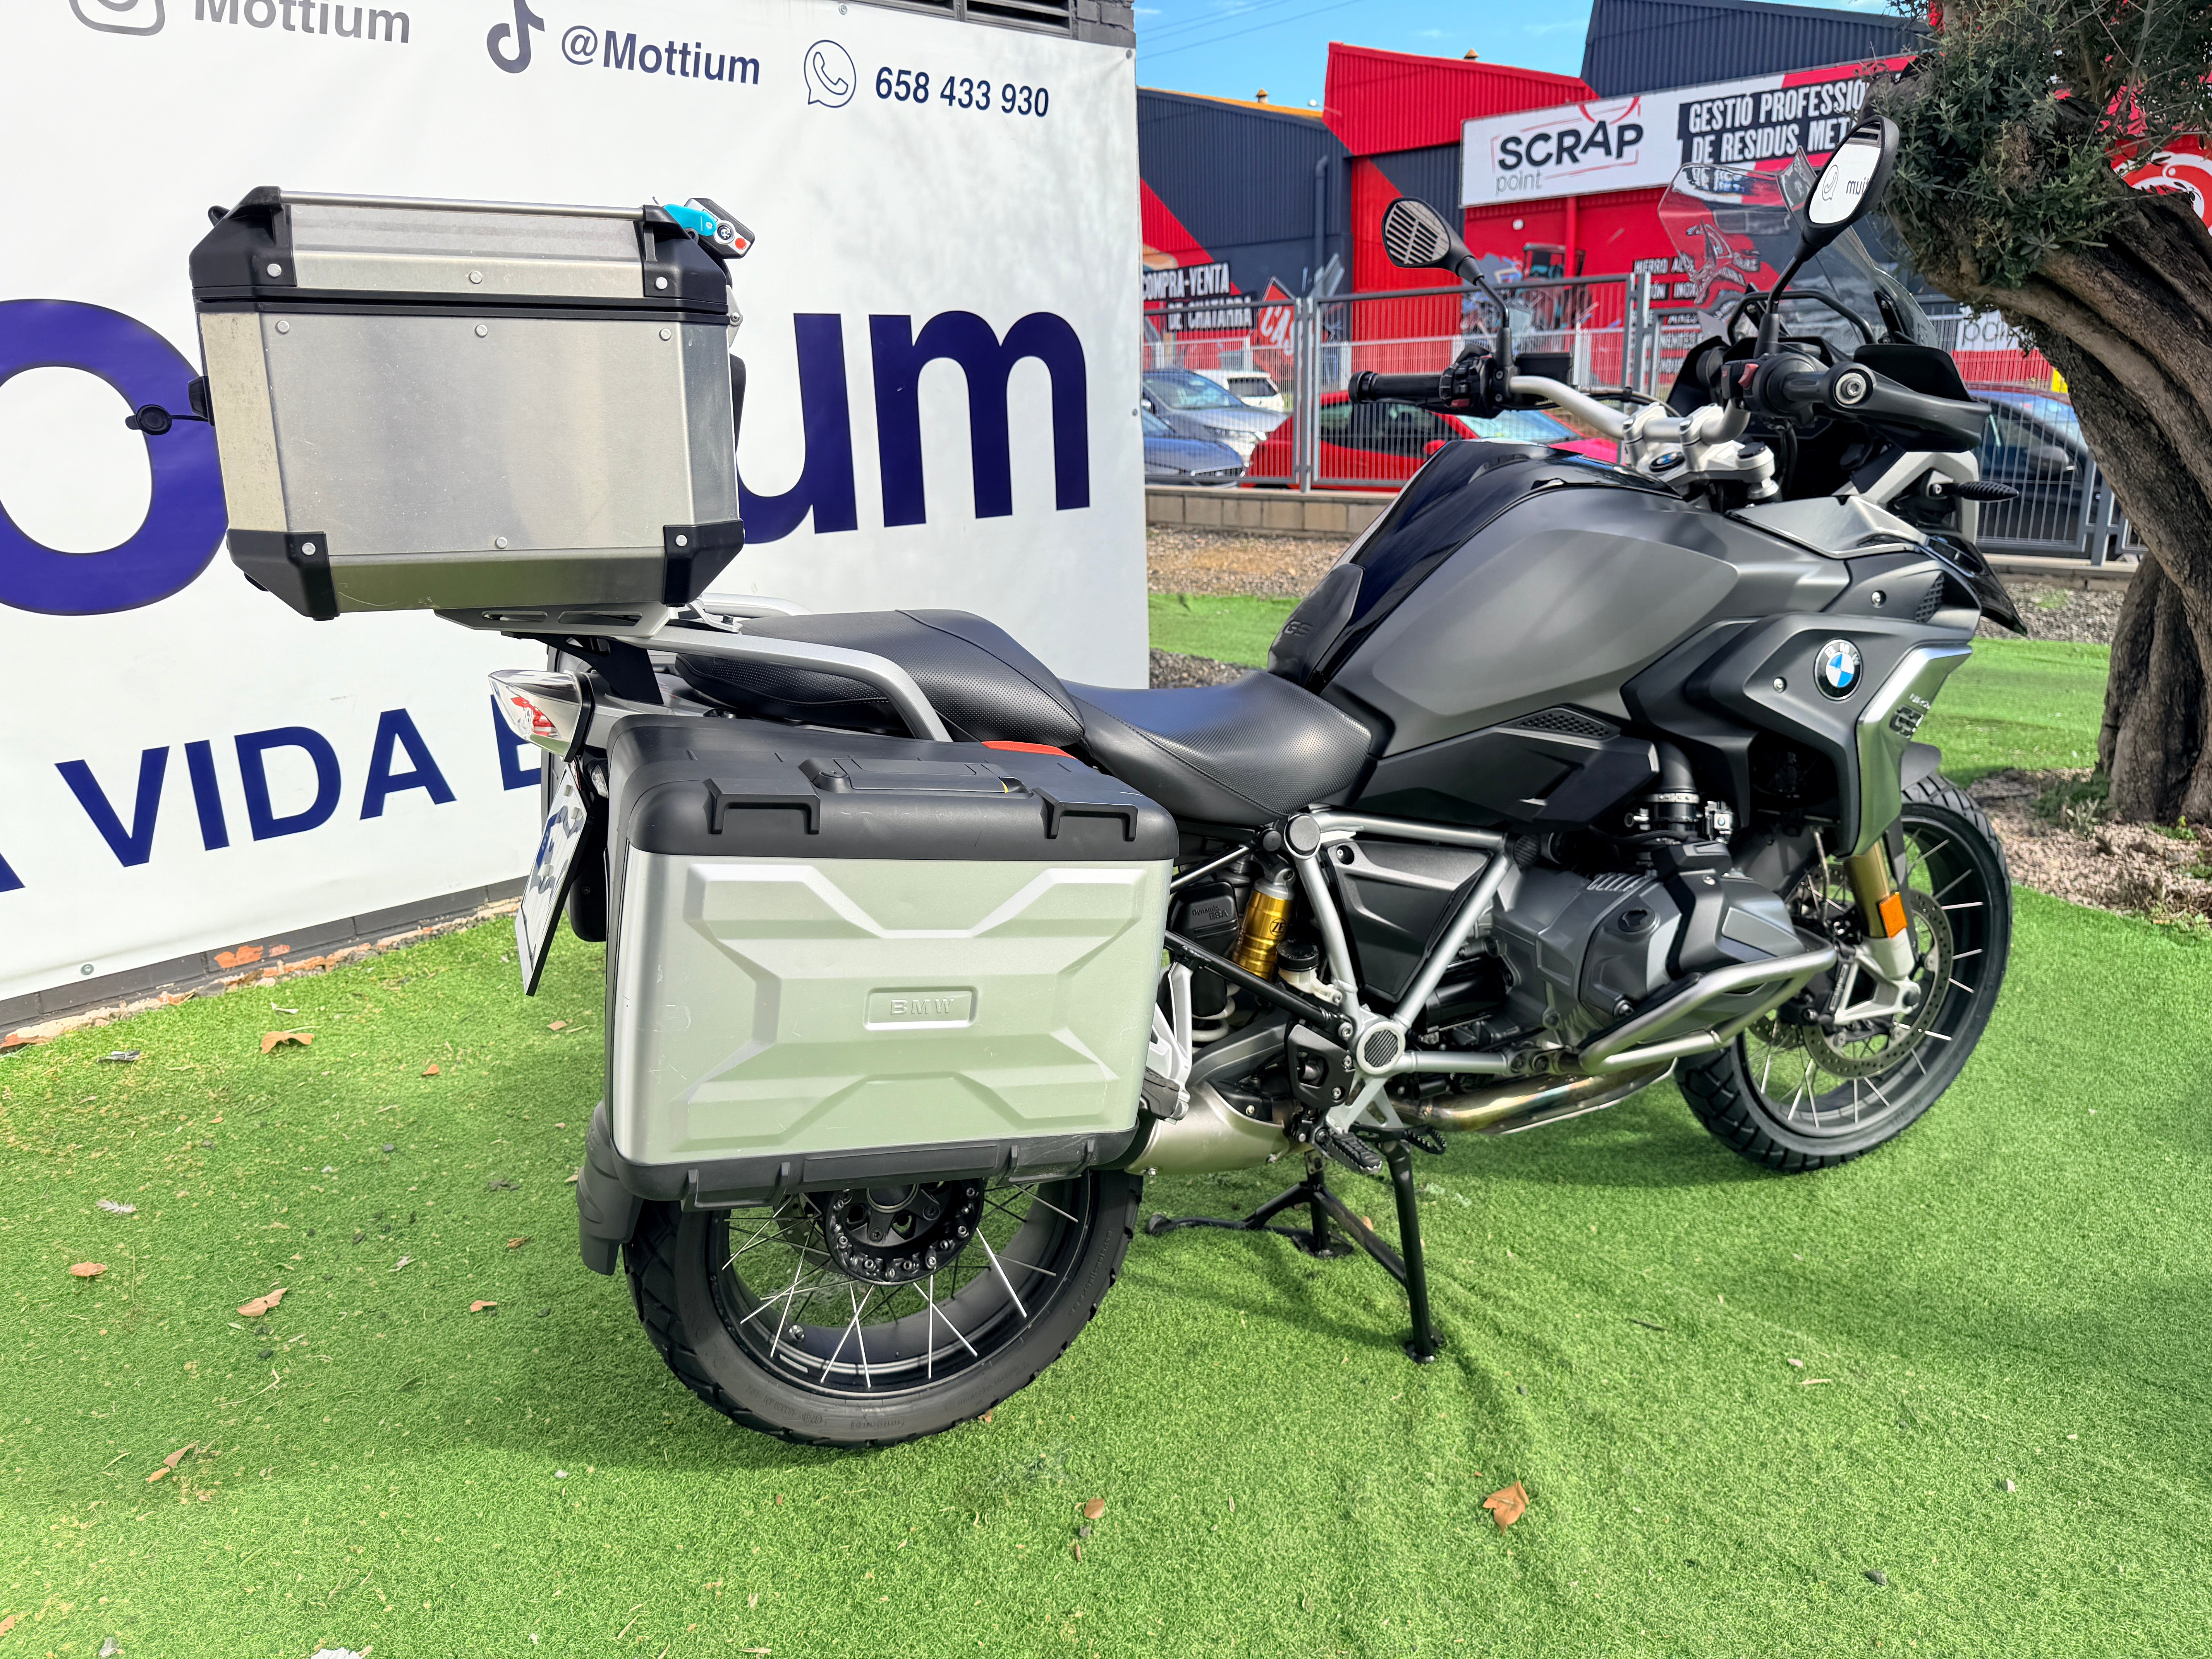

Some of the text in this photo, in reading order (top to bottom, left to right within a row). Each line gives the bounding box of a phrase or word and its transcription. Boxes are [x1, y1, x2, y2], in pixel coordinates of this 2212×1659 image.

[562, 26, 759, 84] @Mottium
[876, 67, 1049, 117] 658 433 930
[1688, 79, 1868, 134] GESTIÓ PROFESSIO
[1499, 120, 1644, 170] SCRAP
[1691, 134, 1715, 164] DE
[1720, 123, 1799, 163] RESIDUS
[1496, 169, 1542, 196] point
[1168, 301, 1183, 330] DE
[1824, 642, 1861, 666] BMW
[55, 708, 456, 867] VIDA
[1271, 921, 1286, 933] ZF
[890, 998, 954, 1015] BMW
